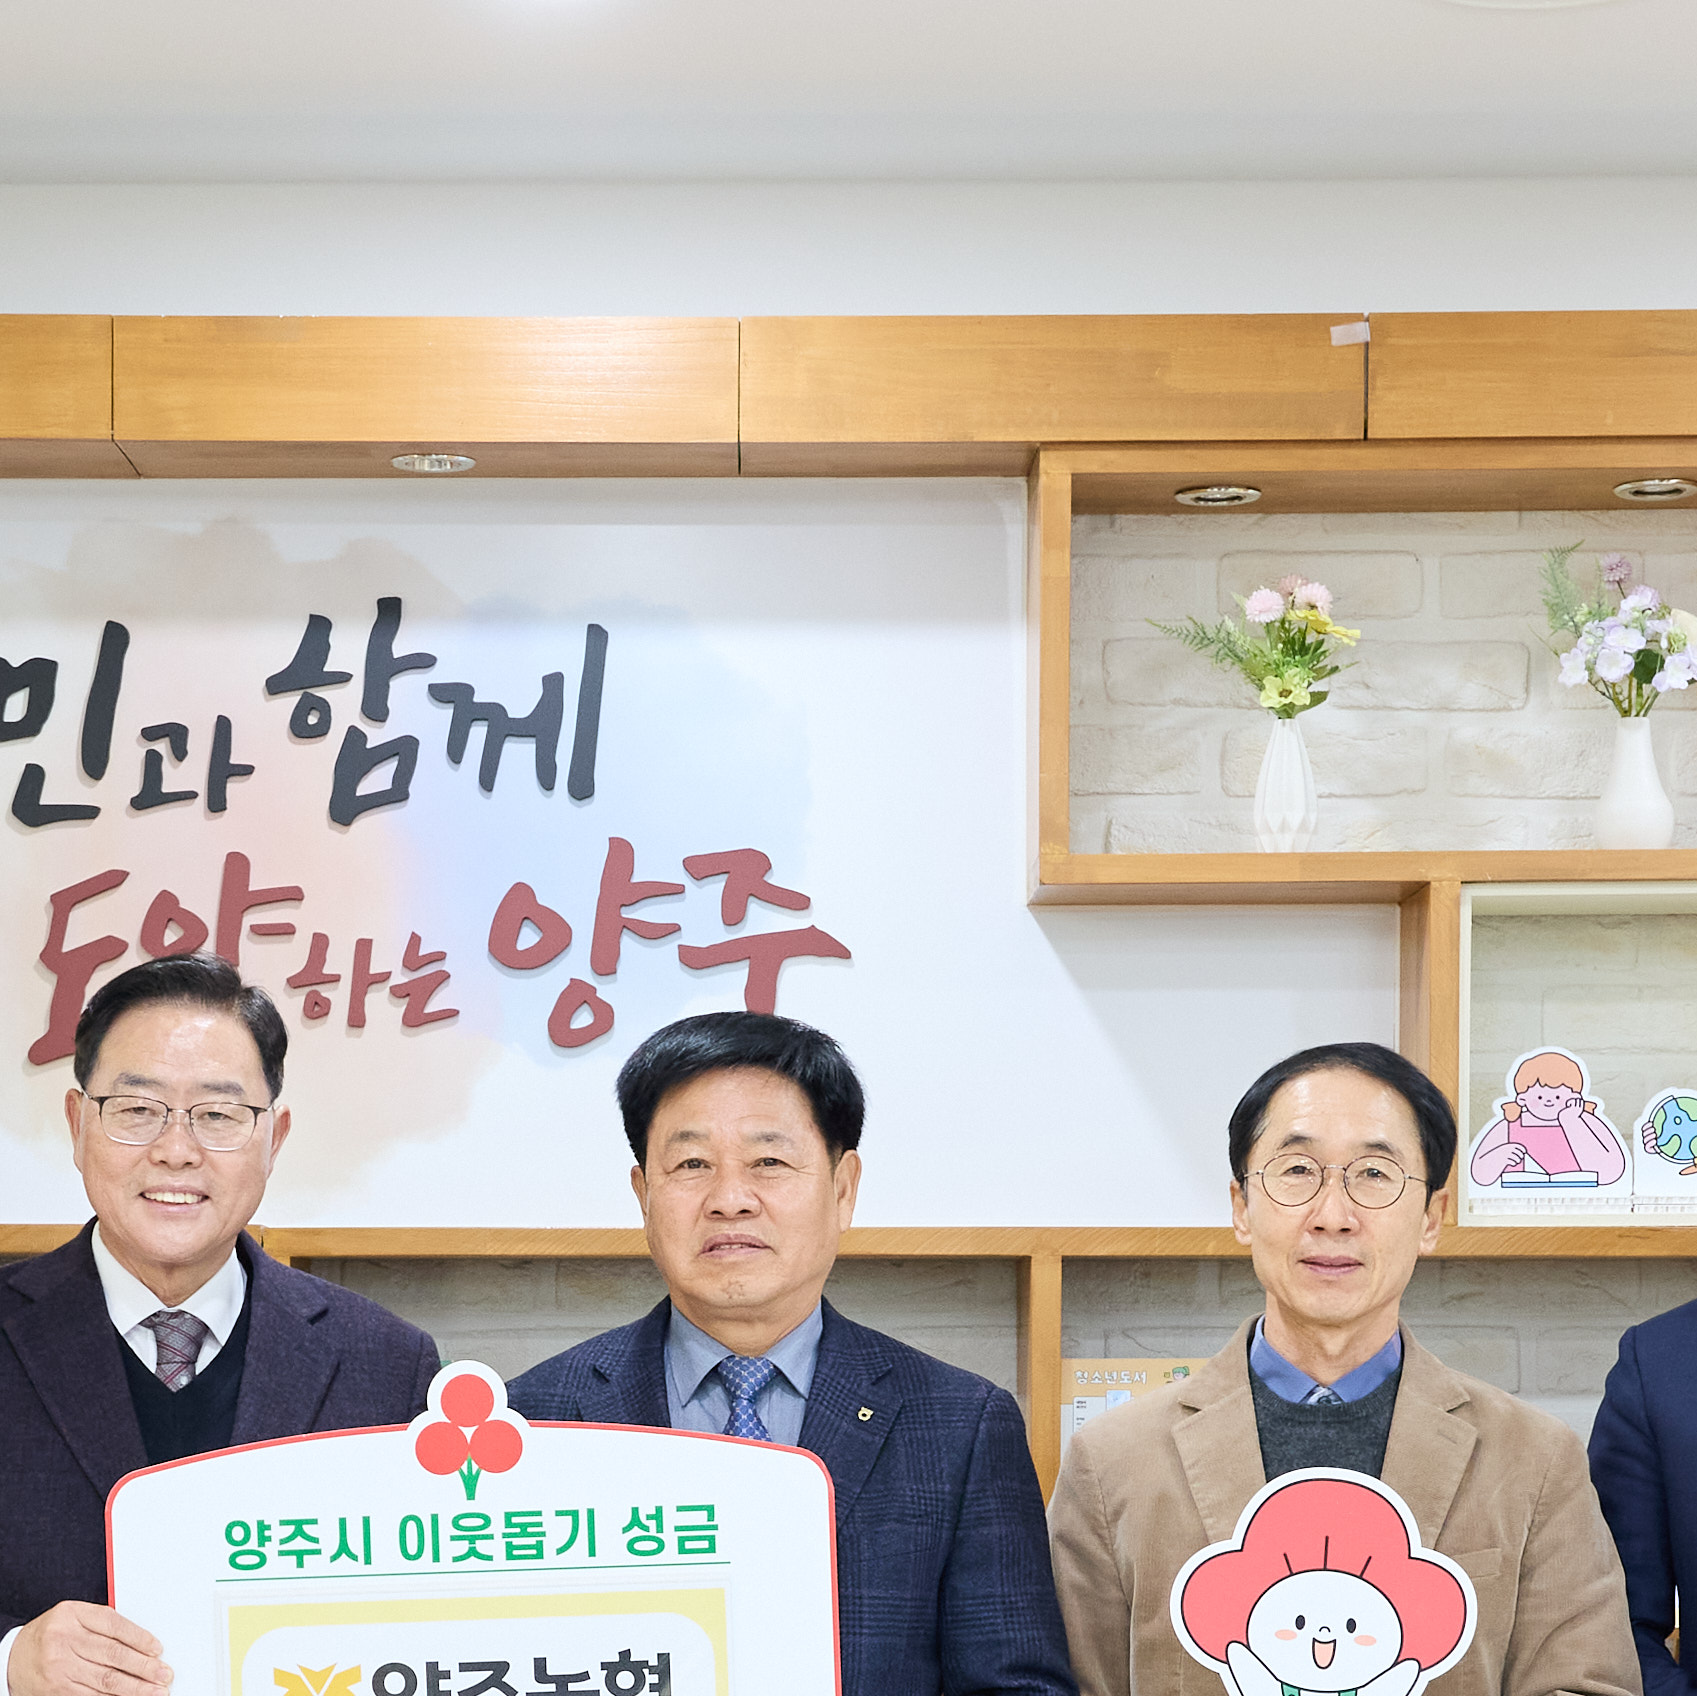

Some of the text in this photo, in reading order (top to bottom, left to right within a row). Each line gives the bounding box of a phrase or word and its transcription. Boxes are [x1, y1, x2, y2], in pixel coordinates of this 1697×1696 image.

[265, 596, 607, 827] 함께
[488, 836, 852, 1048] 양주
[1074, 1370, 1147, 1384] 청소년도서
[223, 1503, 721, 1572] 양주시 이웃돕기 성금
